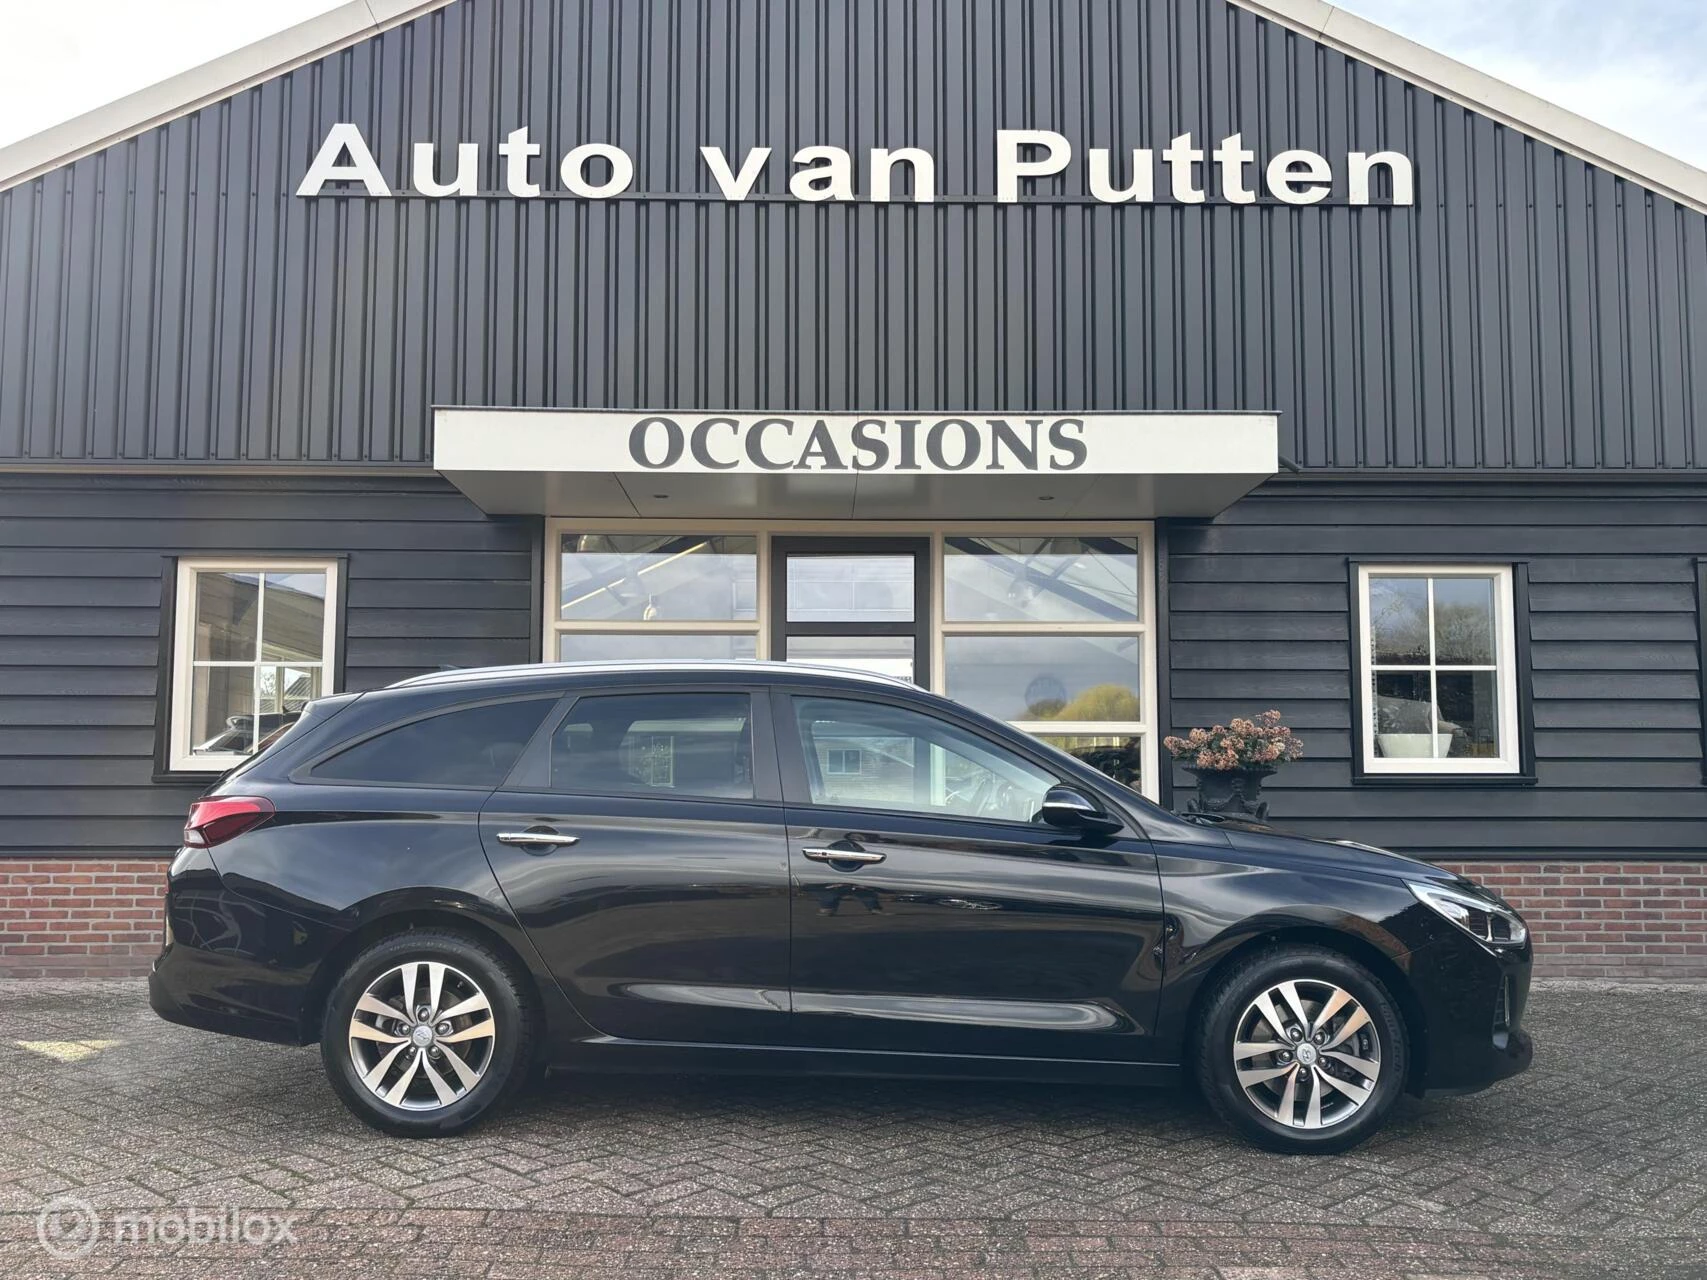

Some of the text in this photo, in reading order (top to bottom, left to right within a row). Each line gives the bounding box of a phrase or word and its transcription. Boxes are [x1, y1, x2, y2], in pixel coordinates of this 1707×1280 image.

[296, 123, 1413, 205] Auto van Putten
[628, 416, 1088, 472] OCCASIONS
